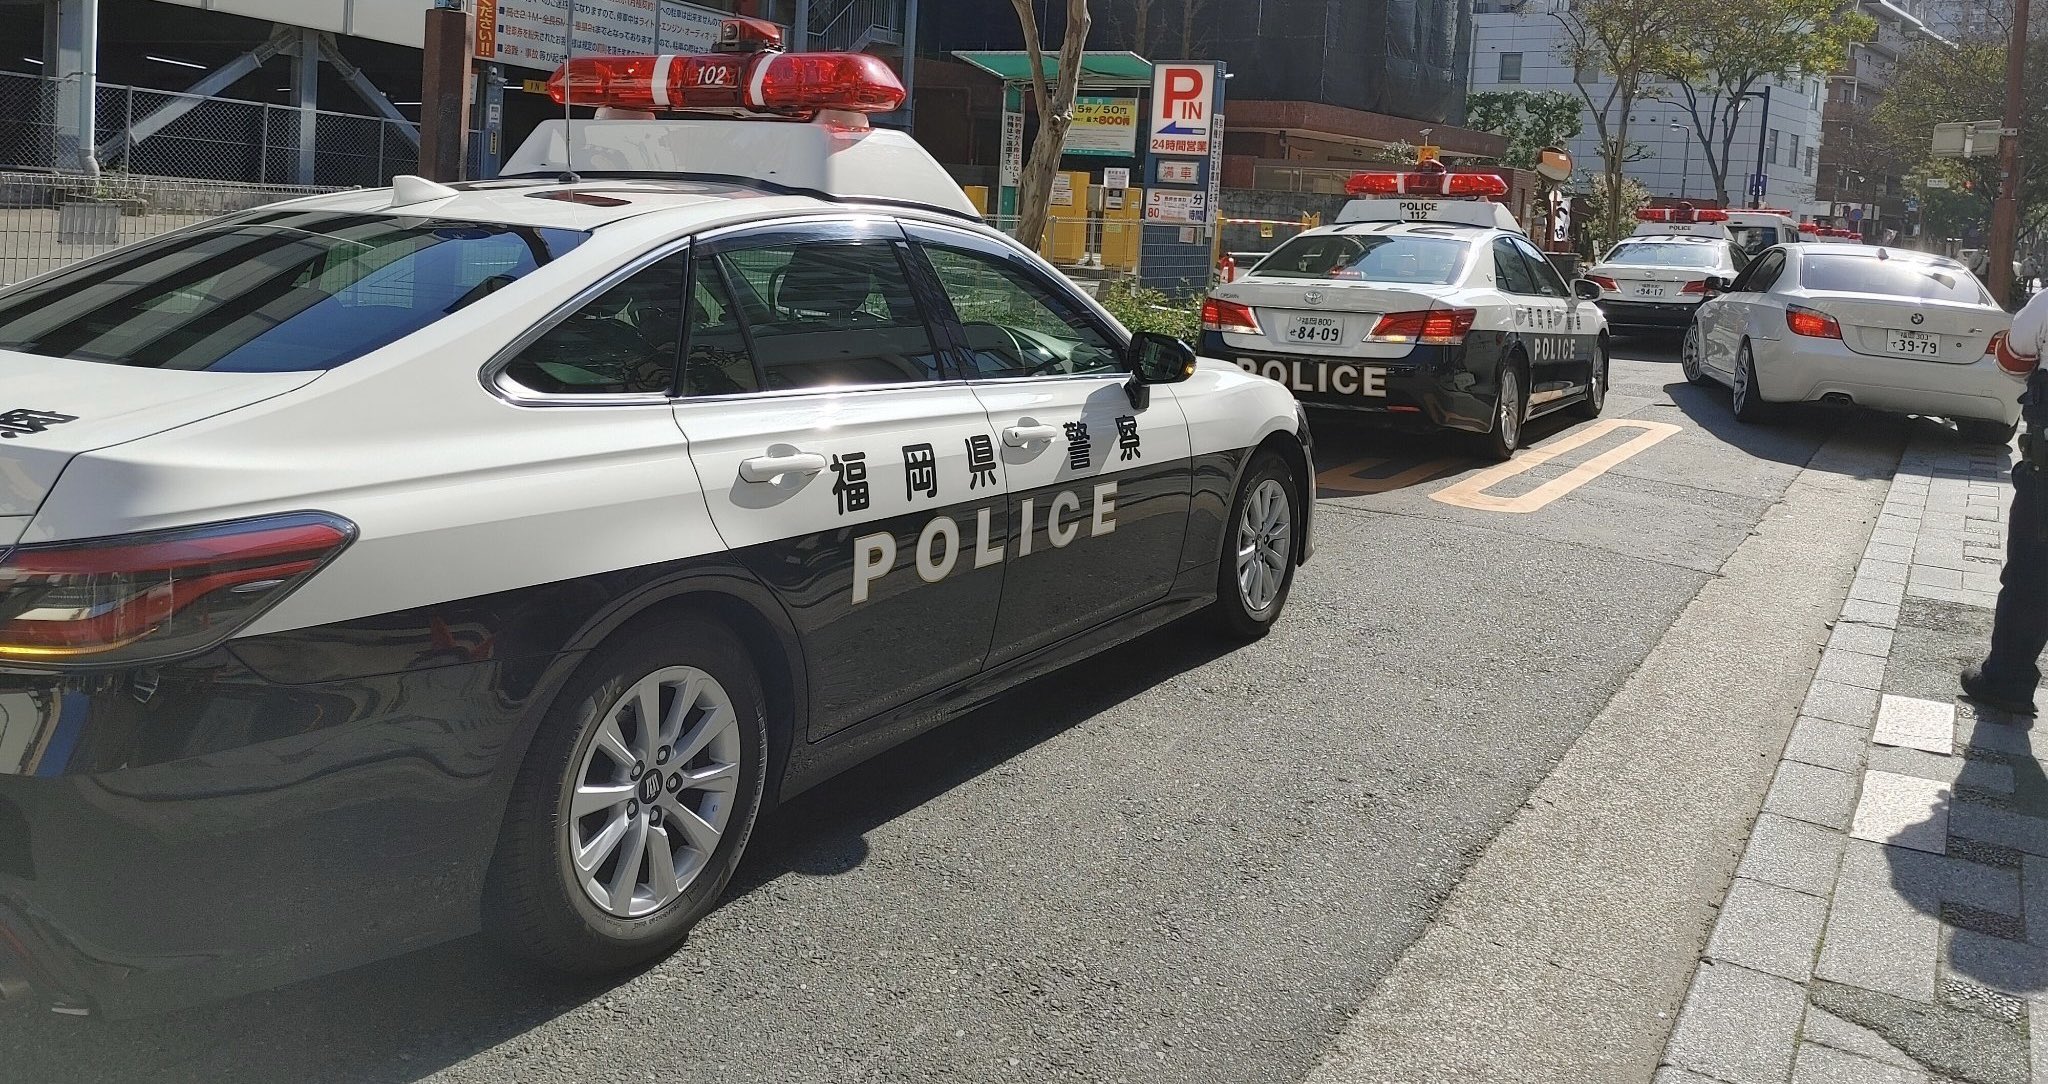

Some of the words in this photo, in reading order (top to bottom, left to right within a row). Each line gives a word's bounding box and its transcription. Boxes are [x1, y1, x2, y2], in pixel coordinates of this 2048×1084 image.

[697, 66, 727, 85] 102
[530, 82, 540, 90] IN
[1162, 68, 1204, 119] P
[1181, 101, 1203, 120] IN
[1151, 139, 1208, 153] 24時間営業
[1399, 202, 1438, 212] POLICE
[1409, 211, 1428, 220] 112
[1317, 318, 1332, 327] 800
[1297, 326, 1340, 342] 84-09
[1534, 338, 1576, 361] POLICE
[1898, 339, 1937, 355] 39-79
[851, 480, 1119, 606] POLICE
